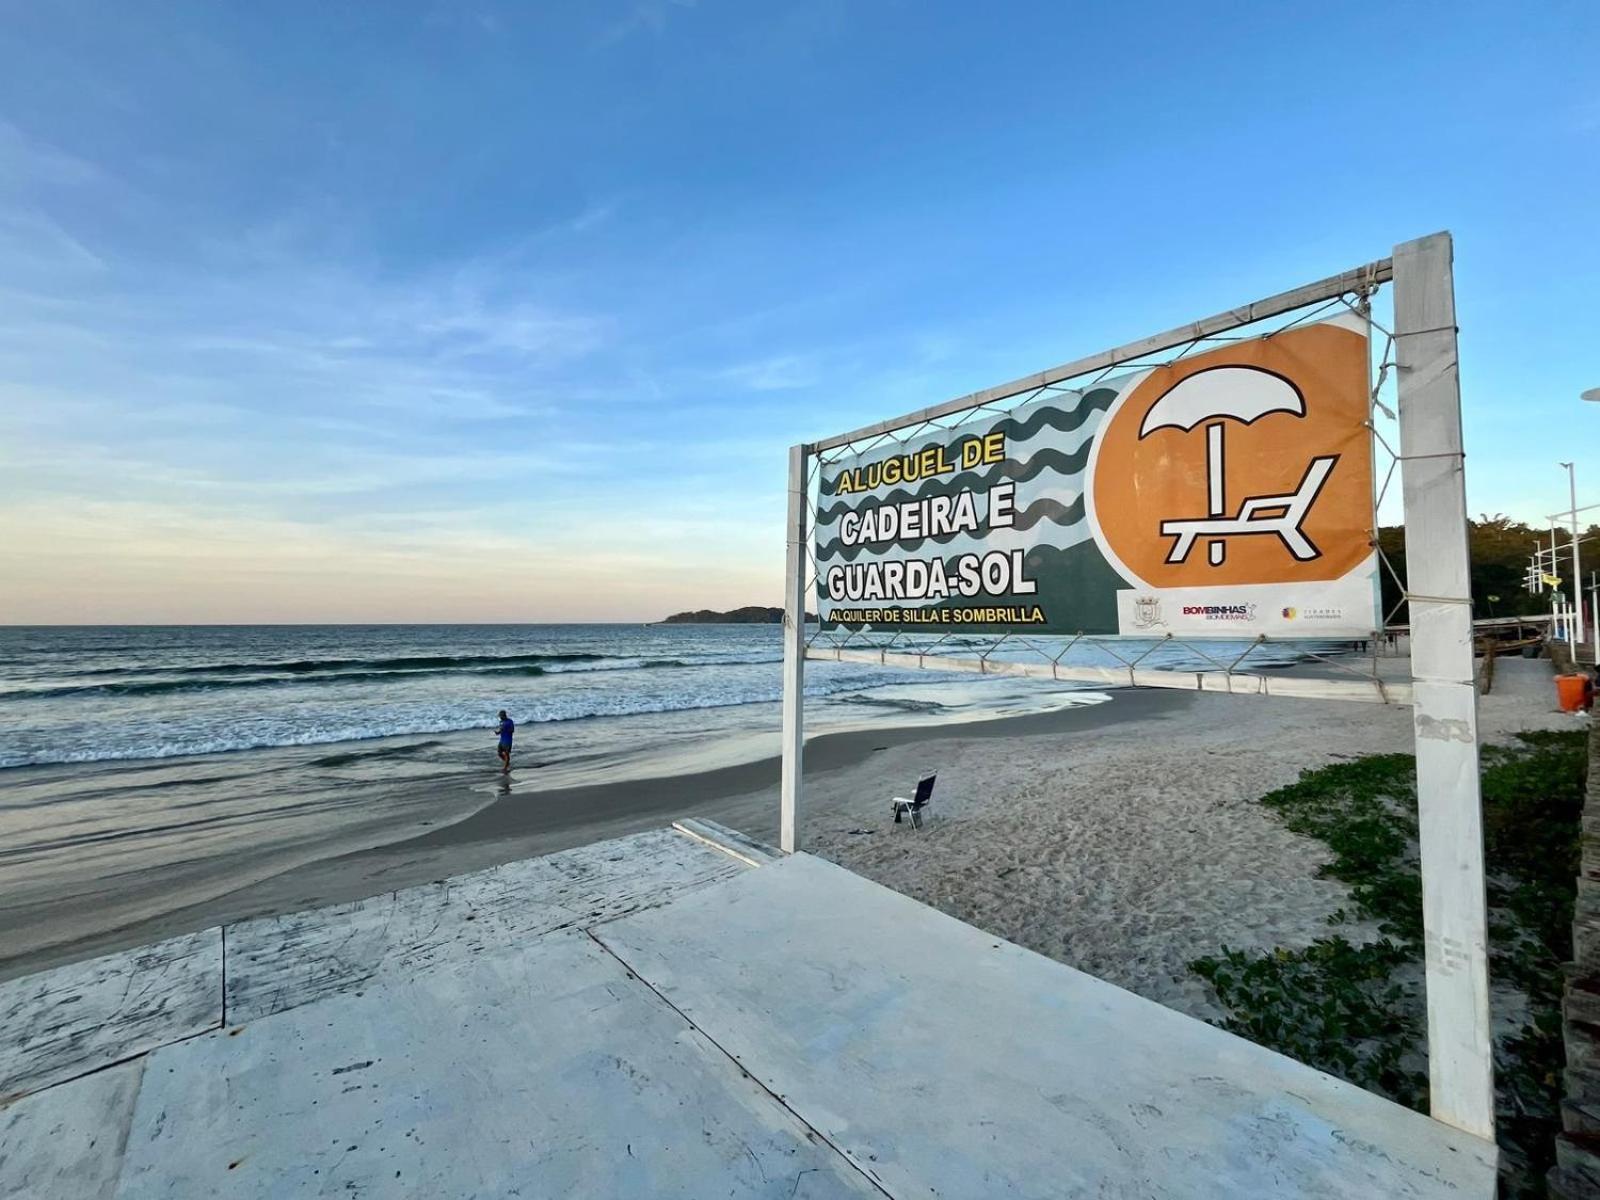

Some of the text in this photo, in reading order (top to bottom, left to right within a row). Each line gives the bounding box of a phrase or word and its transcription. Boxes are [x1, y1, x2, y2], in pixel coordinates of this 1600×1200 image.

[836, 433, 1006, 495] ALUGUEL DE
[840, 481, 1016, 545] CADEIRA E
[828, 550, 1036, 601] GUARDA-SOL
[830, 607, 1044, 623] ALQUILER DE SILLA E SOMBRILLA
[1183, 606, 1247, 615] BOMBINHAS
